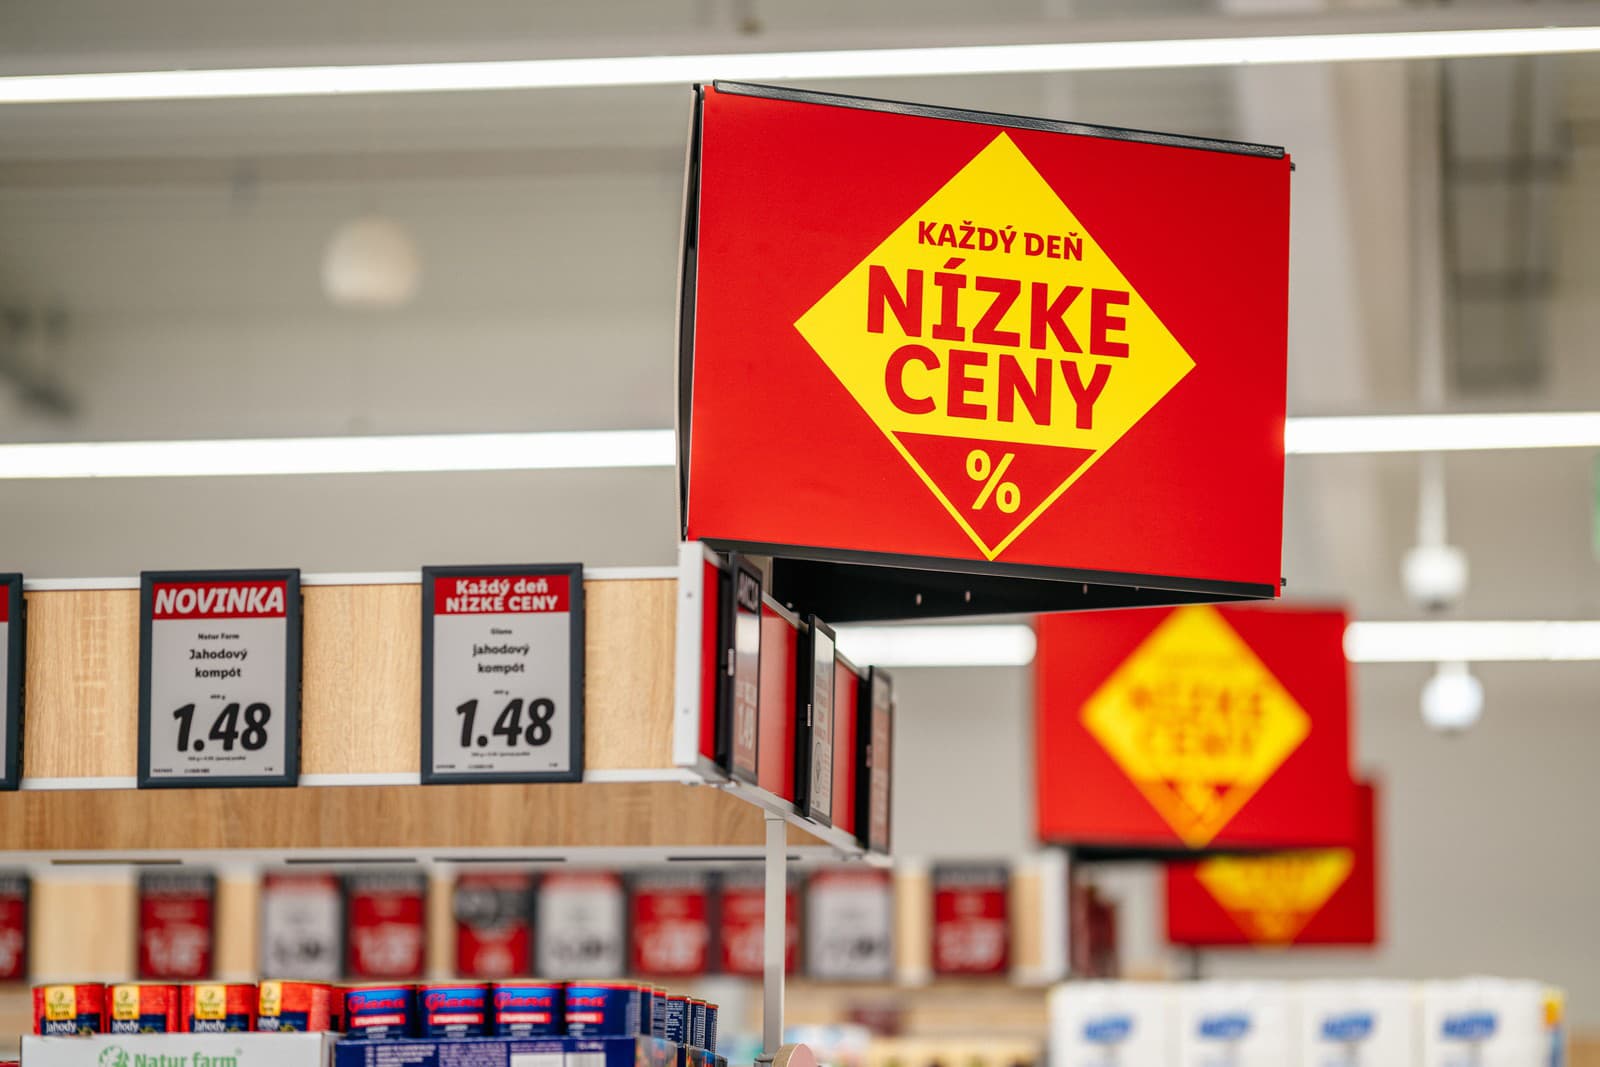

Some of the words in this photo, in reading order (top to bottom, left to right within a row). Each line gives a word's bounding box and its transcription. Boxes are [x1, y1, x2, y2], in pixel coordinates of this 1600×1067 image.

[918, 220, 1017, 254] KAŽDÝ
[1023, 231, 1083, 261] DEŇ
[866, 257, 1130, 358] NÍZKE
[884, 344, 1113, 430] CENY
[965, 448, 1022, 514] %
[154, 586, 284, 614] NOVINKA
[456, 578, 510, 597] Každý
[513, 578, 548, 594] deň
[445, 594, 505, 612] NÍZKE
[508, 596, 558, 611] CENY
[189, 649, 248, 661] Jahodový
[472, 644, 530, 657] jahodový
[195, 667, 242, 680] kompót
[477, 663, 525, 675] kompót
[173, 702, 271, 752] 1.48
[456, 697, 555, 748] 1.48
